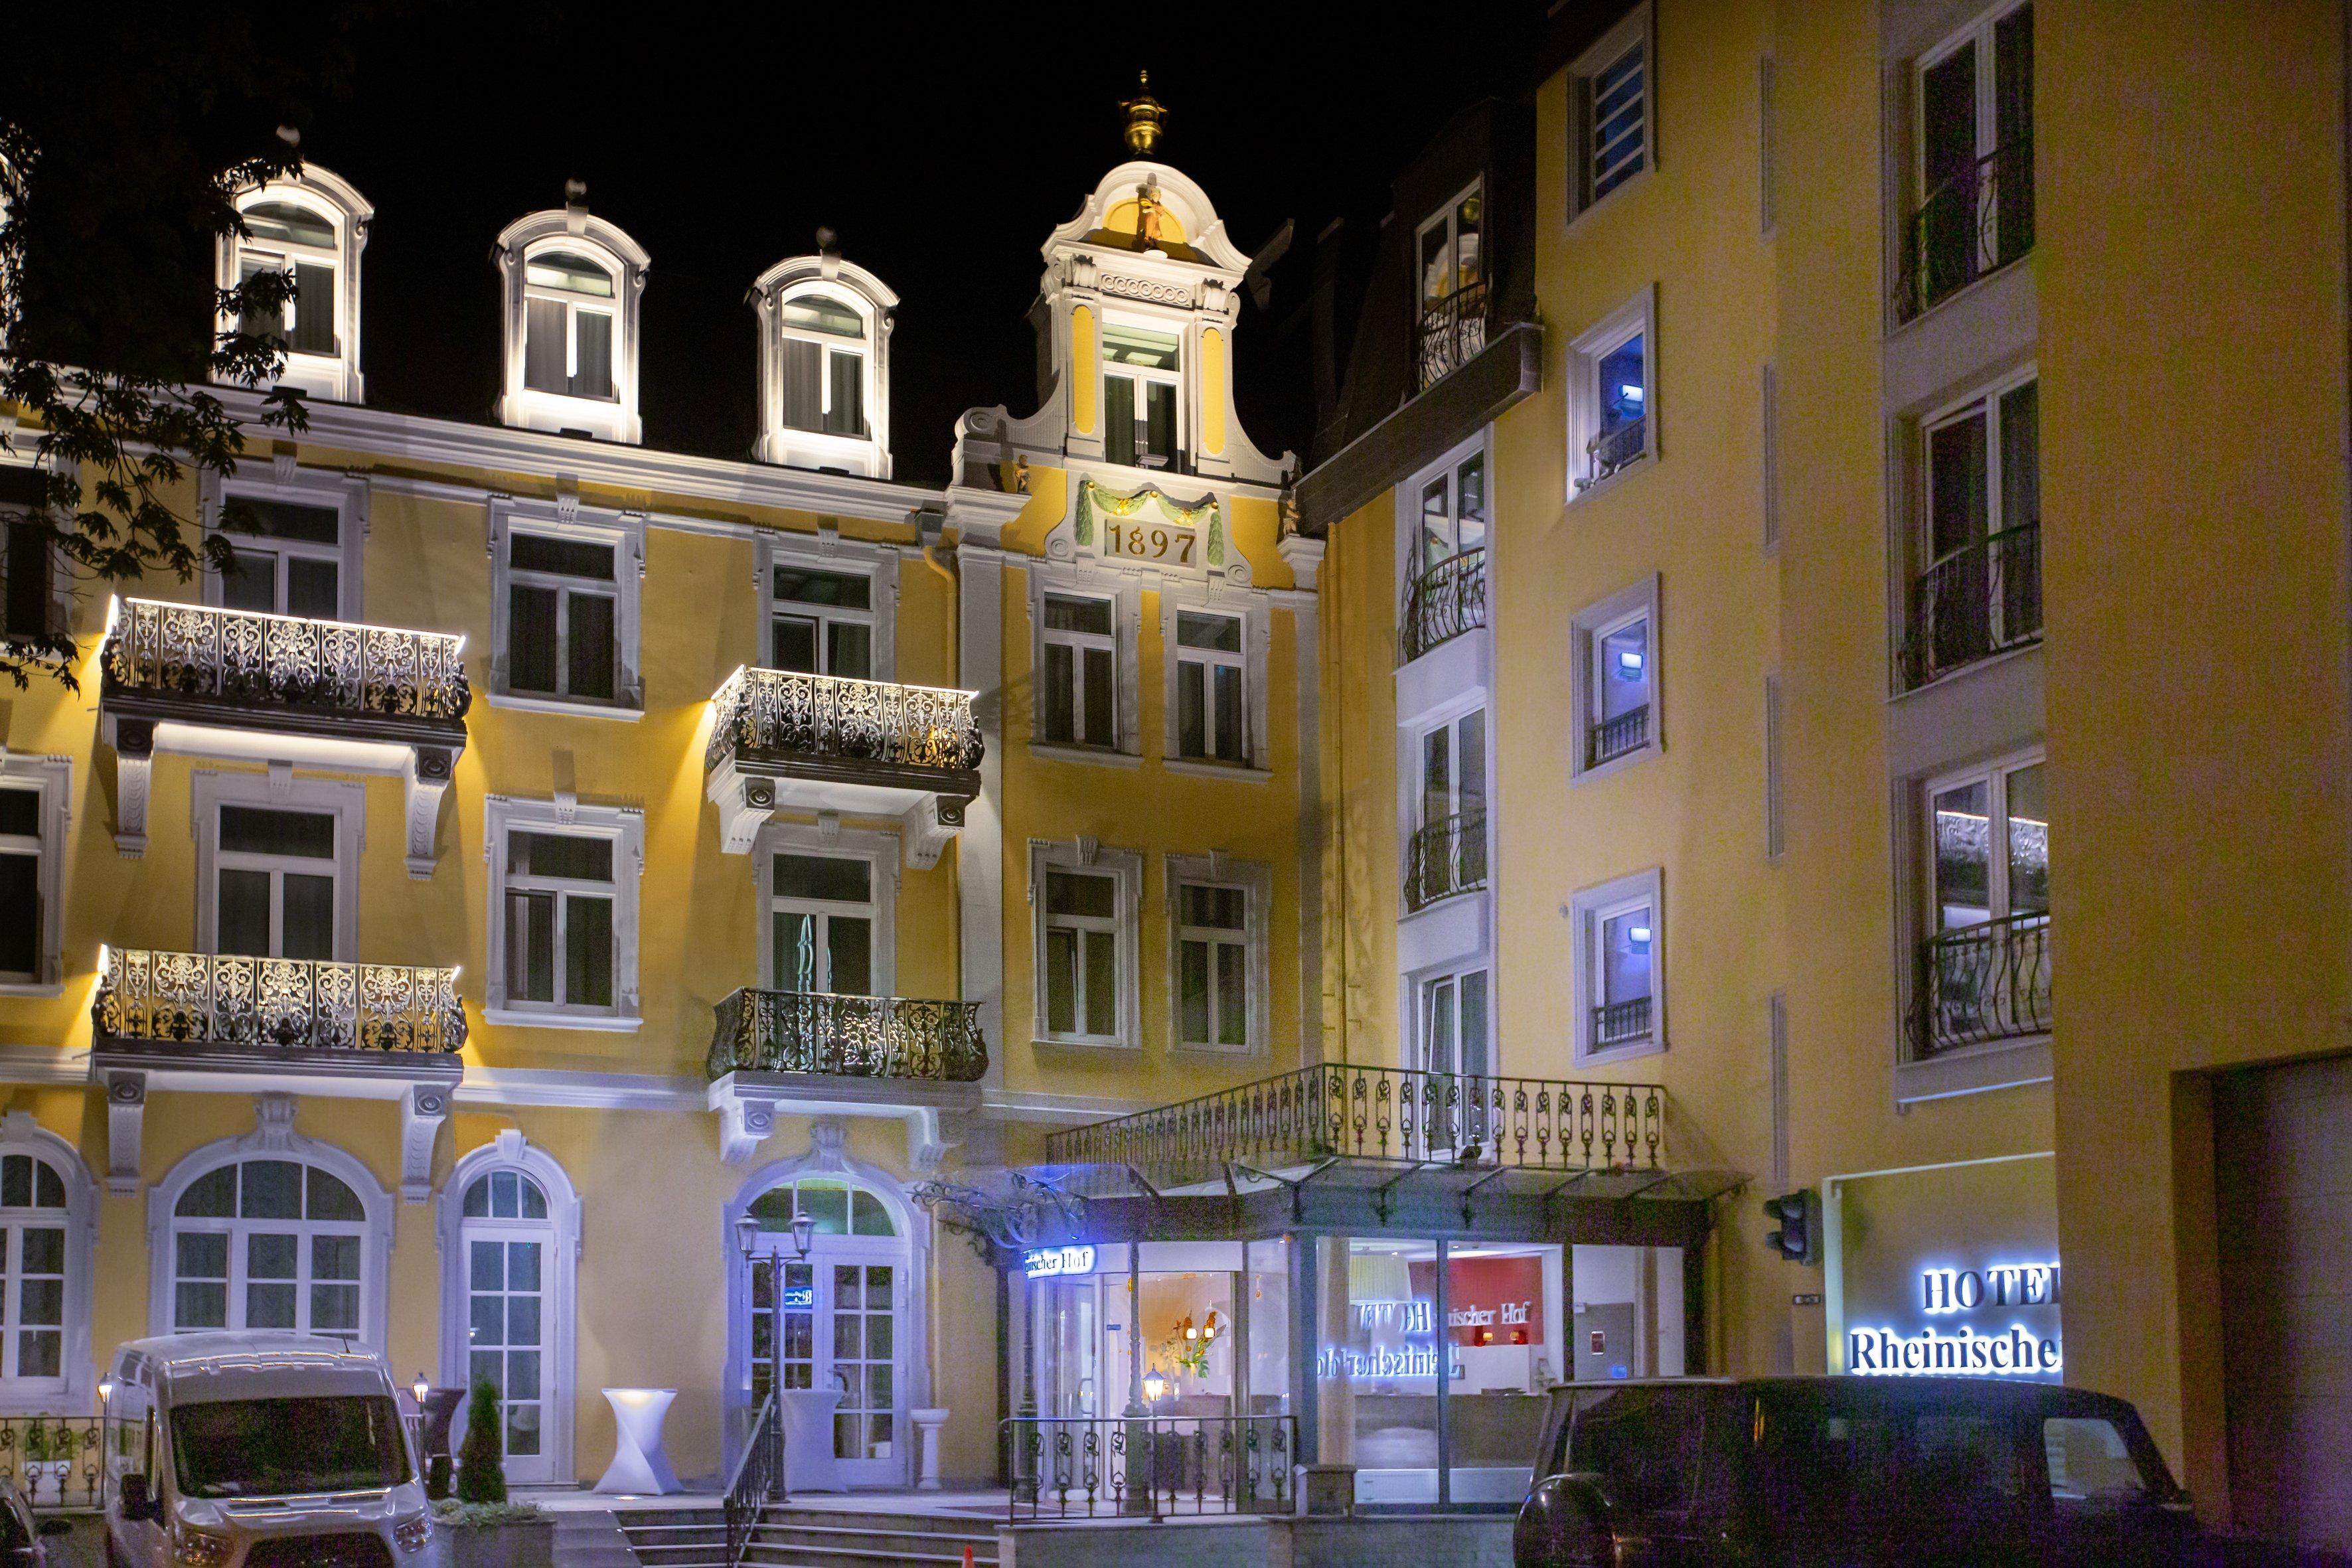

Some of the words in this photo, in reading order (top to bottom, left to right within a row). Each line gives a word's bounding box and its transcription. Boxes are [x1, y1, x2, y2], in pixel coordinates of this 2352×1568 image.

[1109, 524, 1196, 563] 1897
[1061, 1251, 1089, 1269] Hof
[1500, 1300, 1531, 1324] Hof
[1849, 1329, 2063, 1370] Rheinische
